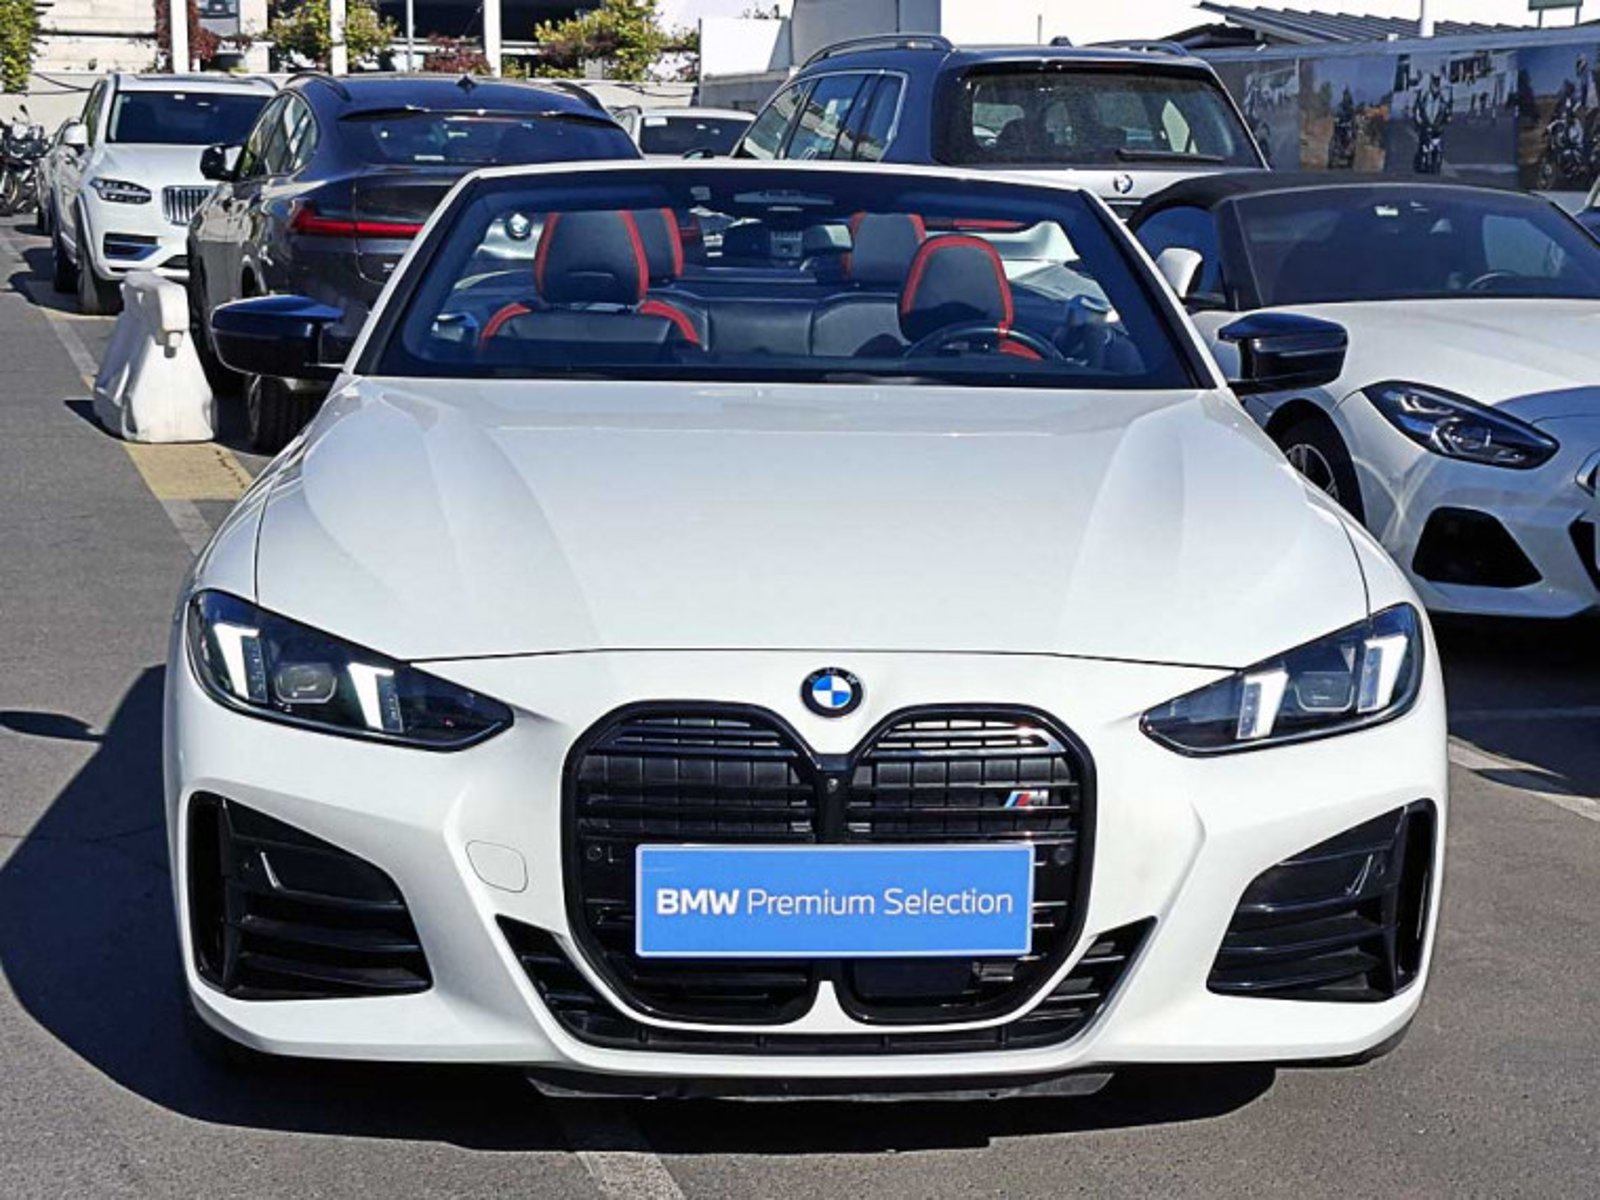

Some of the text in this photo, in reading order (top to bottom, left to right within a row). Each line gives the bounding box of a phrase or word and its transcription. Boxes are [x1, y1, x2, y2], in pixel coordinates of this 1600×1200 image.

[655, 887, 1014, 916] BMW Premium Selection
